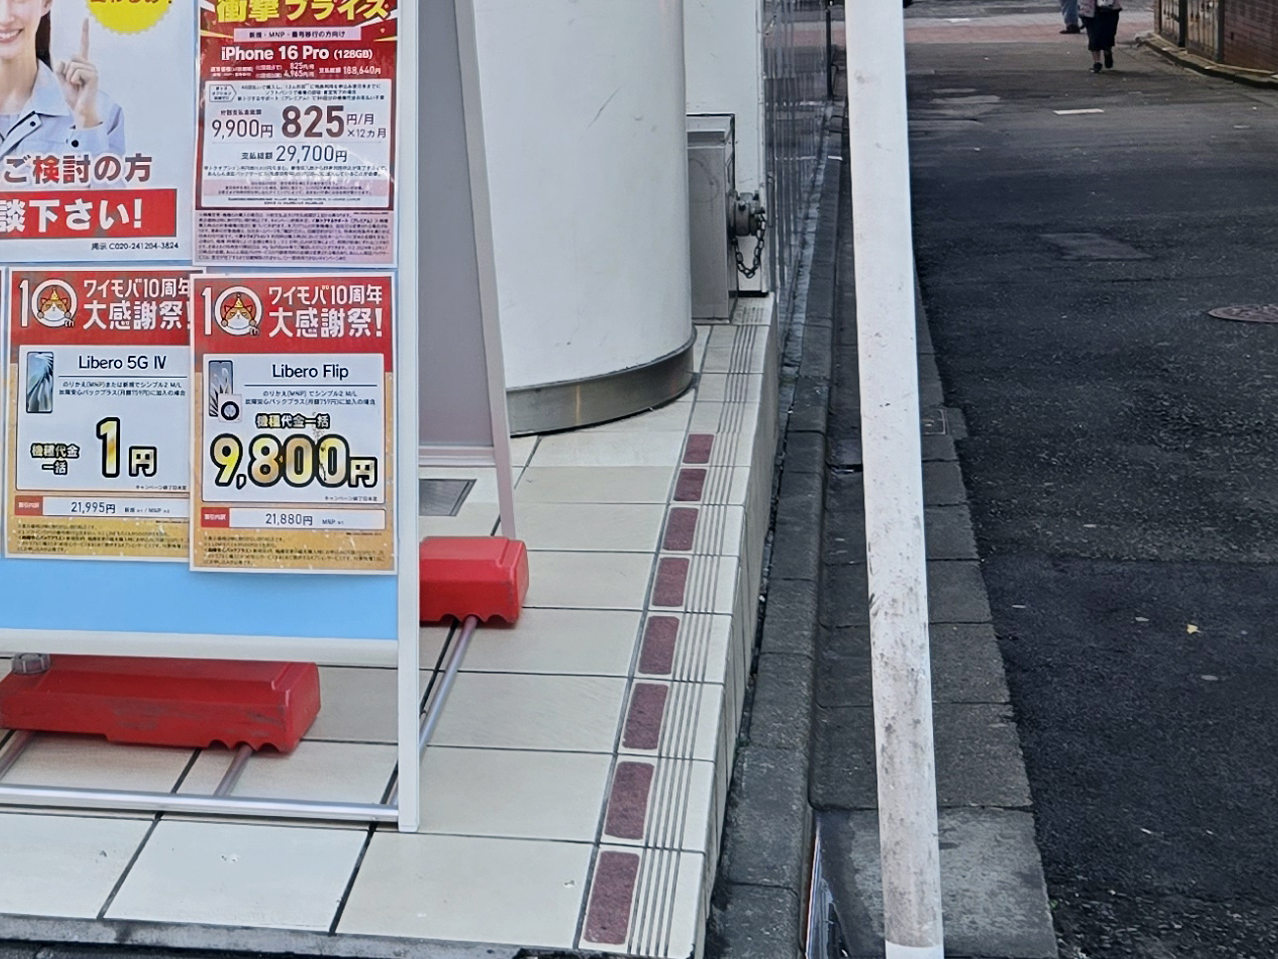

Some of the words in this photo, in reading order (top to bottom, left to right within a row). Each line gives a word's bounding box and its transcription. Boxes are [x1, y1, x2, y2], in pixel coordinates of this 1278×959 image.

[221, 46, 274, 61] iPhone
[278, 45, 298, 60] 16
[302, 45, 329, 60] Pro
[333, 48, 373, 60] (128GB)
[281, 105, 345, 139] 825
[346, 113, 375, 126] 円/月
[211, 119, 274, 140] 9,900円
[275, 145, 348, 164] 29,700円
[83, 277, 190, 298] ワイモバ10周年
[268, 284, 383, 306] ワイモバ10周年
[268, 307, 383, 338] 大感謝祭!
[78, 355, 123, 370] Libero
[127, 355, 148, 370] 5G
[272, 364, 319, 379] Libero
[323, 364, 349, 381] Flip
[255, 413, 331, 429] 機種代金一括
[30, 443, 80, 458] 機種代金
[42, 460, 68, 475] 一括
[209, 433, 378, 490] 9,800円
[70, 501, 116, 514] 21,995円
[265, 513, 313, 526] 21,880円
